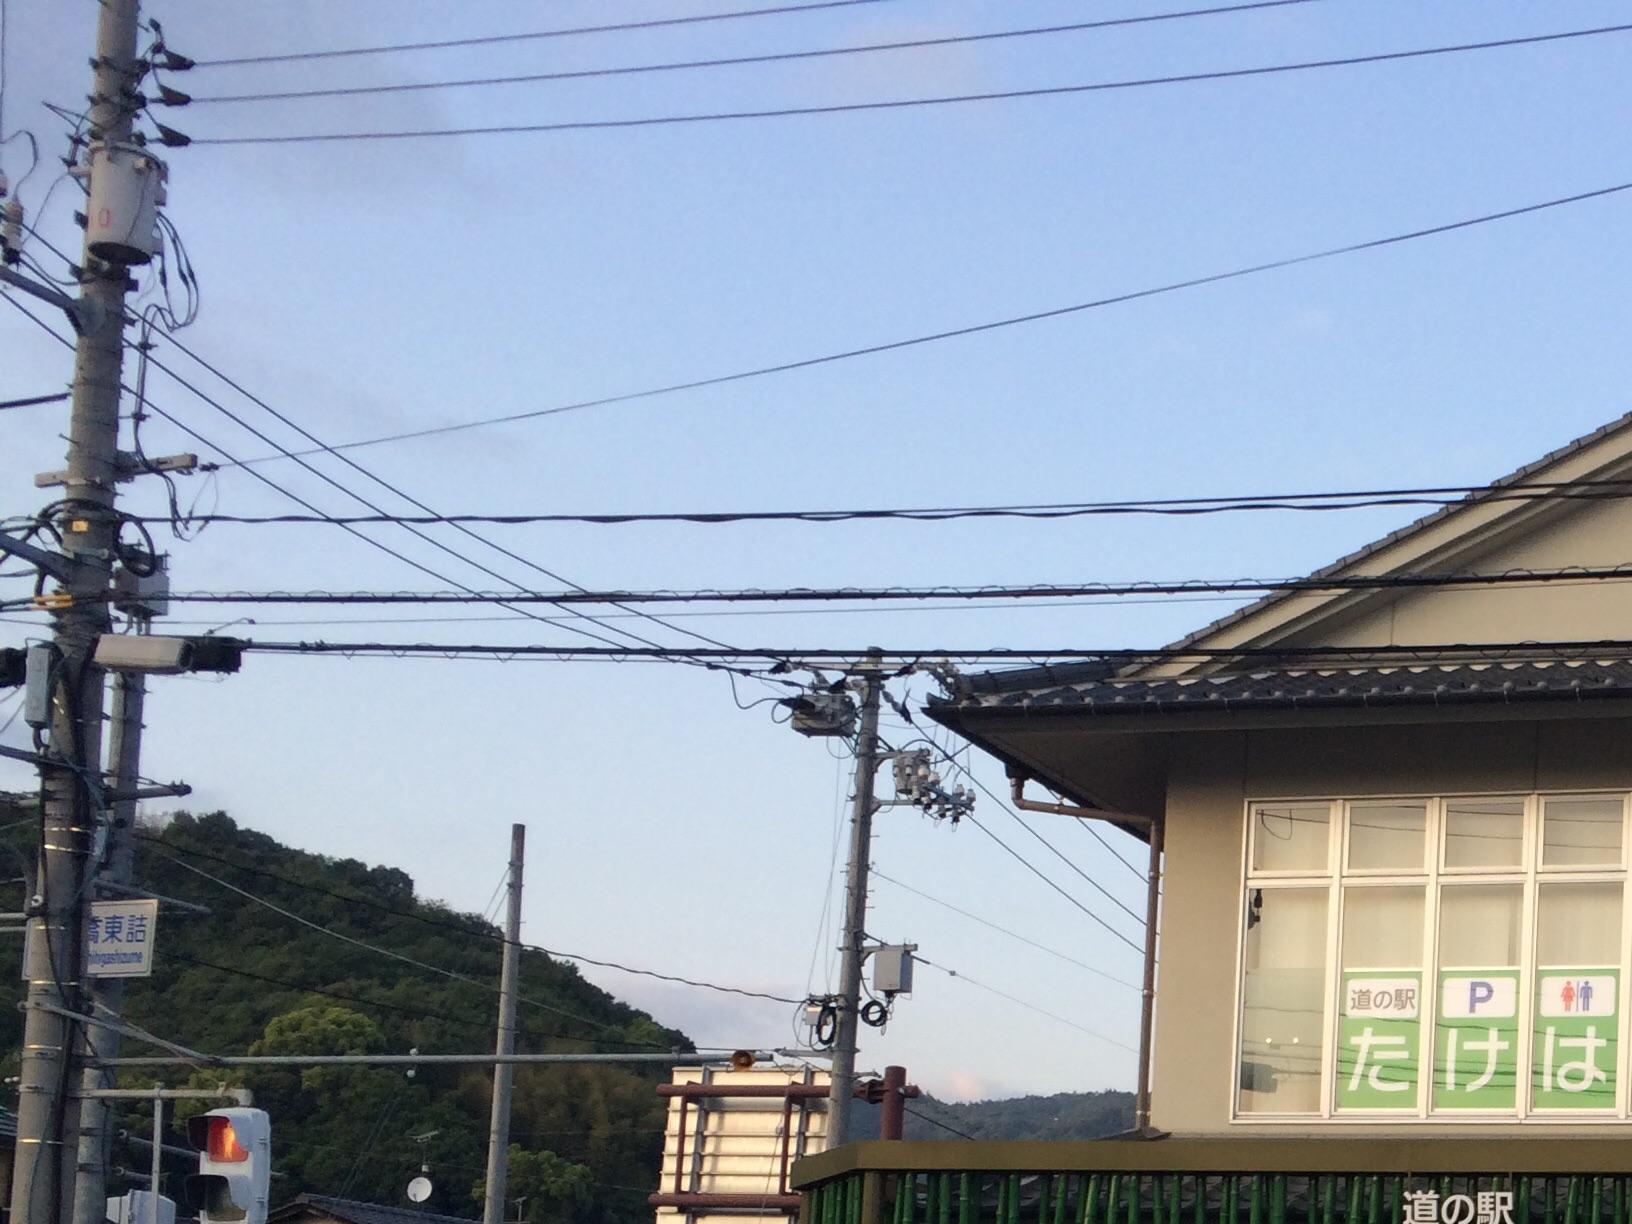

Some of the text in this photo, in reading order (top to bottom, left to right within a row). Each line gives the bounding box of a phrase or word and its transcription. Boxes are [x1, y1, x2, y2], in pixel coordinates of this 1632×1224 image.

[1350, 988, 1416, 1011] 道の駅
[1468, 980, 1494, 1014] P
